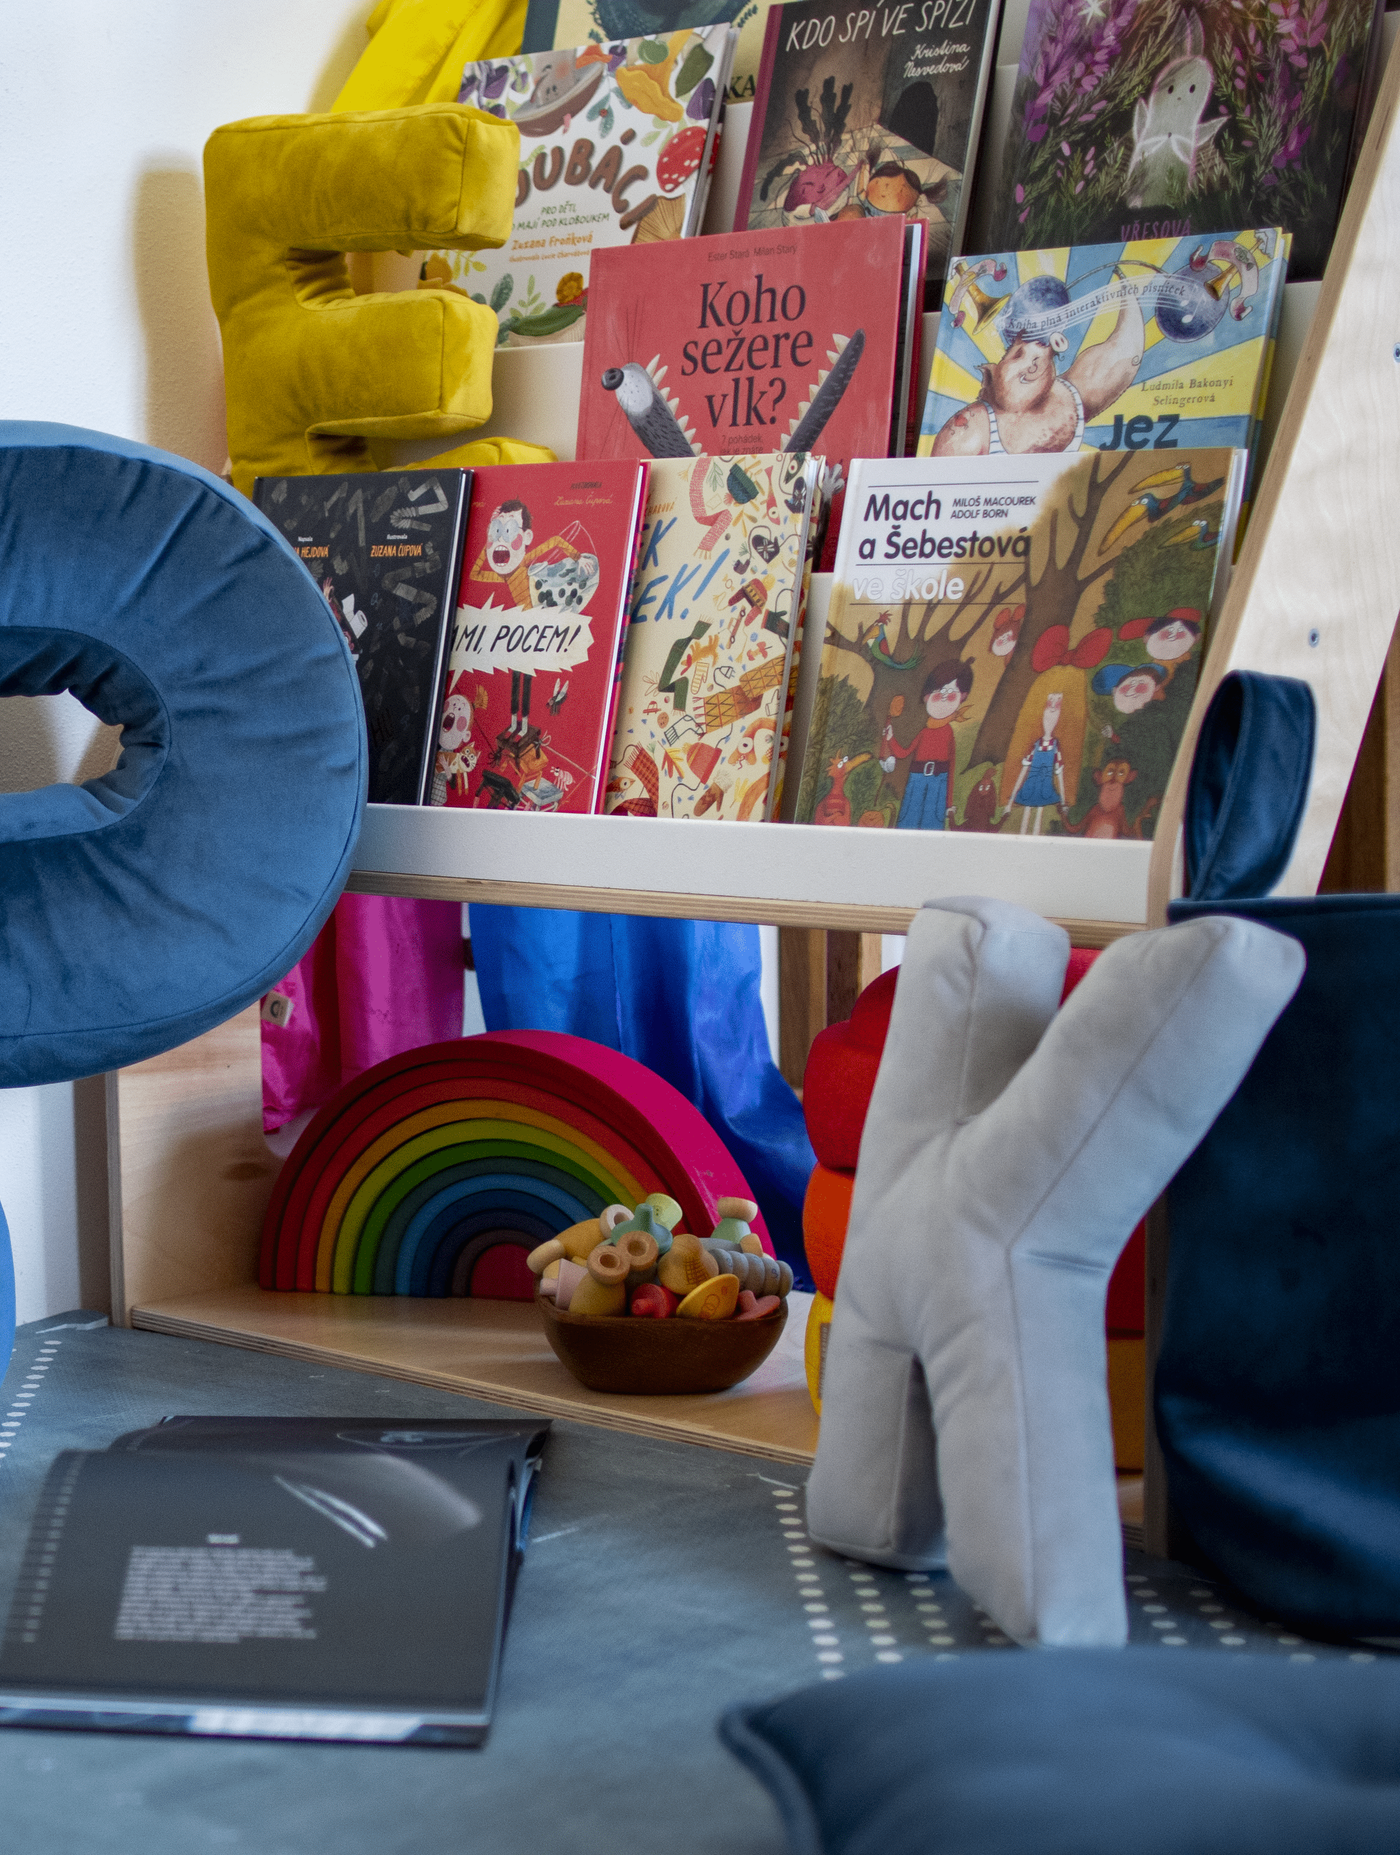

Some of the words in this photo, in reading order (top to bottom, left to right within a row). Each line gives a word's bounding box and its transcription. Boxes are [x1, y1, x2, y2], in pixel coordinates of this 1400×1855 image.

[785, 15, 836, 51] KDO
[839, 0, 884, 43] SPÍ
[881, 3, 914, 37] VE
[910, 39, 971, 61] Kristina
[903, 56, 969, 79] Nesvedová
[541, 206, 557, 215] PRO
[541, 218, 557, 228] POD
[558, 213, 610, 226] KLOBOUKEM
[708, 251, 727, 262] Ester
[698, 274, 806, 328] Koho
[1008, 318, 1037, 330] Kniha
[1041, 315, 1062, 330] plná
[681, 328, 814, 376] sežere
[1141, 380, 1184, 392] Ludmila
[1189, 376, 1234, 390] Bakonyi
[705, 376, 787, 428] vlk?
[1153, 393, 1216, 408] Selingerová
[864, 490, 941, 521] Mach
[952, 495, 981, 507] MILOŠ
[983, 495, 1037, 507] MACOUREK
[951, 509, 980, 519] ADOLF
[982, 508, 1009, 519] BORN
[301, 544, 330, 558] HEJDOVÁ
[370, 545, 397, 557] ZUZANA
[398, 543, 424, 557] ČUPOVÁ
[858, 538, 876, 560] a
[884, 525, 1032, 560] Šebestová
[630, 548, 730, 623] EK!
[853, 577, 884, 600] ve
[890, 568, 965, 600] škole
[489, 624, 582, 653] POCEM!
